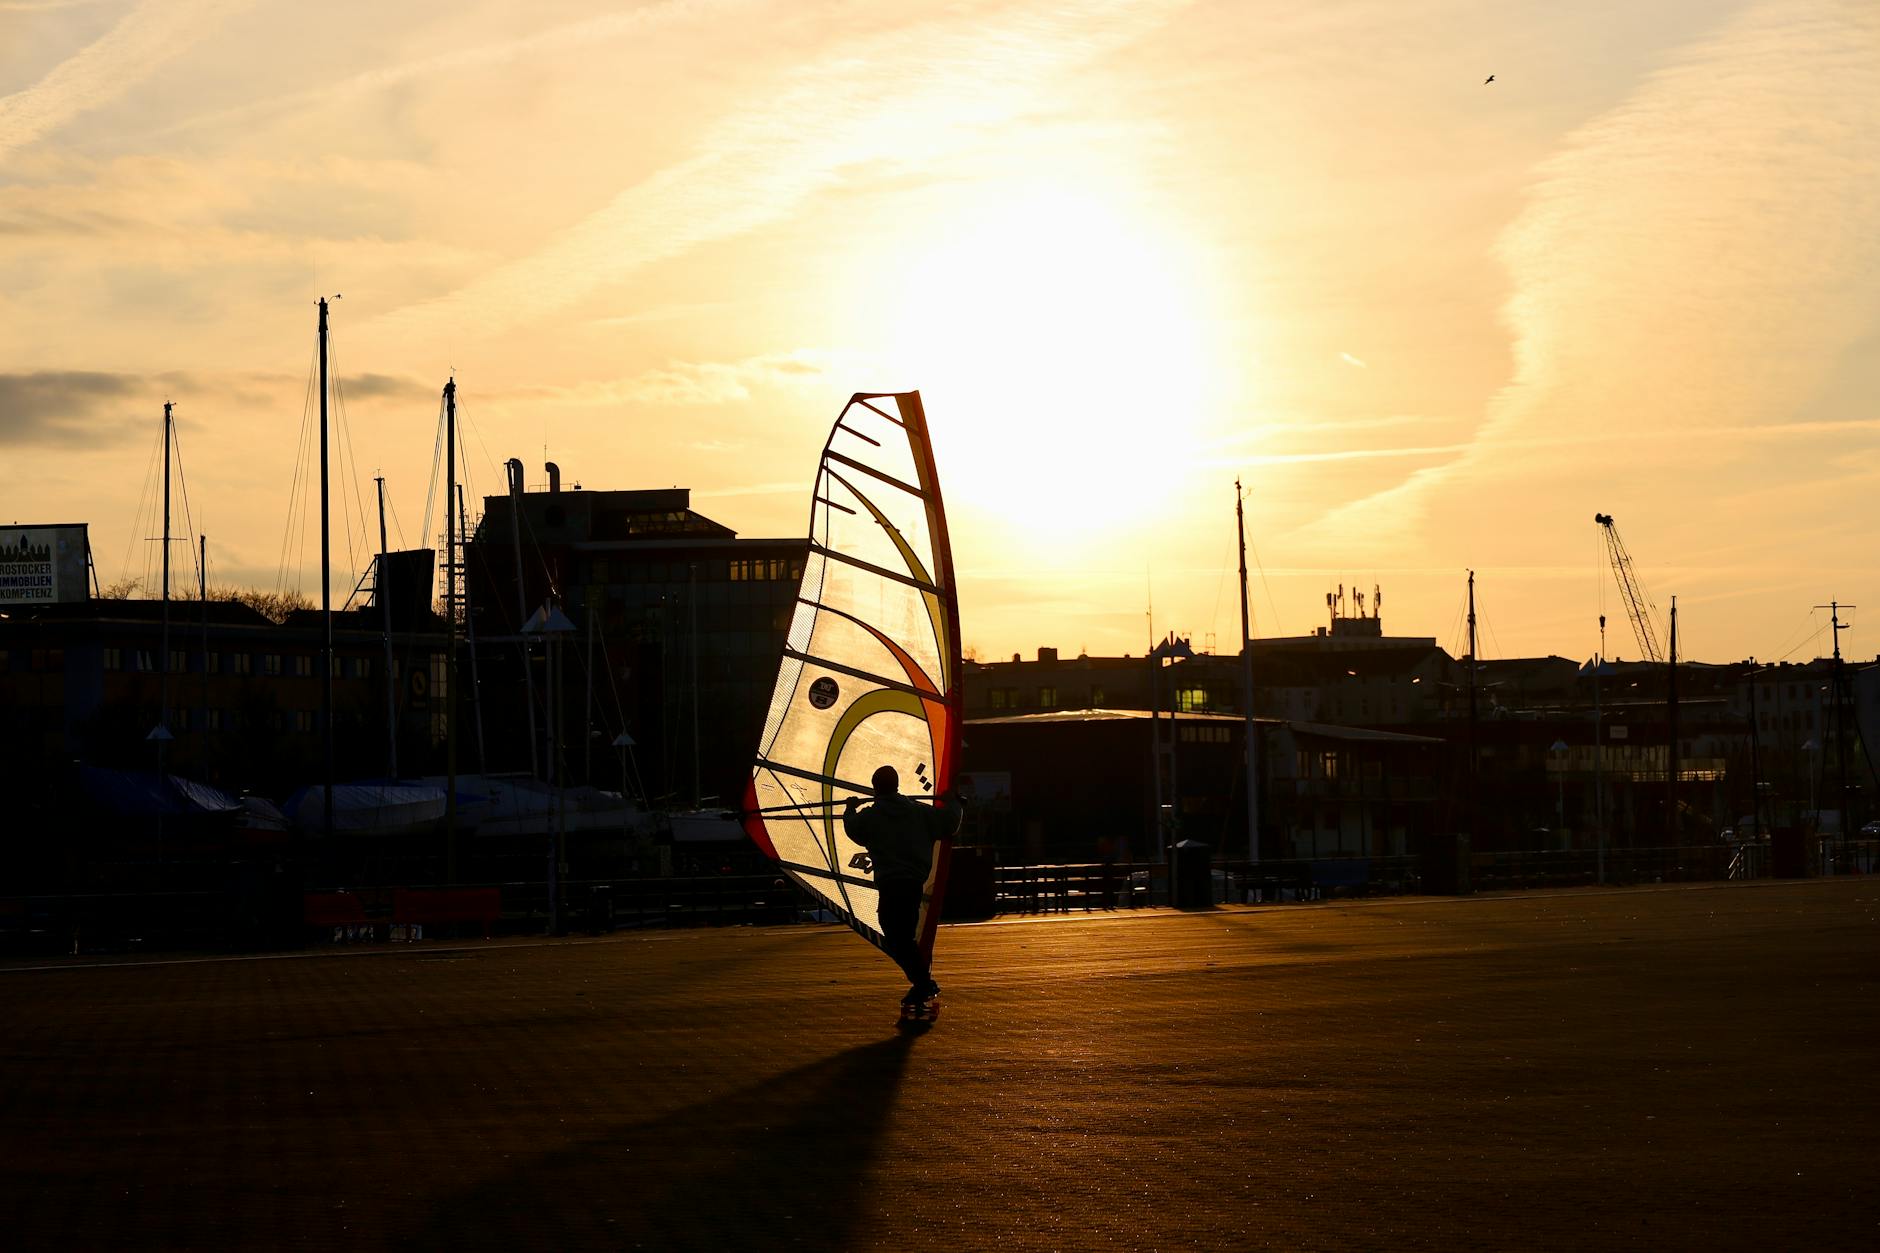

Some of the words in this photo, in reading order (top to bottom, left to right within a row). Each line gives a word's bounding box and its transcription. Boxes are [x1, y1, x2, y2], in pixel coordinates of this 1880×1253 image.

[0, 563, 52, 575] ROSTOCKER
[0, 576, 52, 587] IMMOBILIEN
[0, 588, 53, 599] KOMPETENZ
